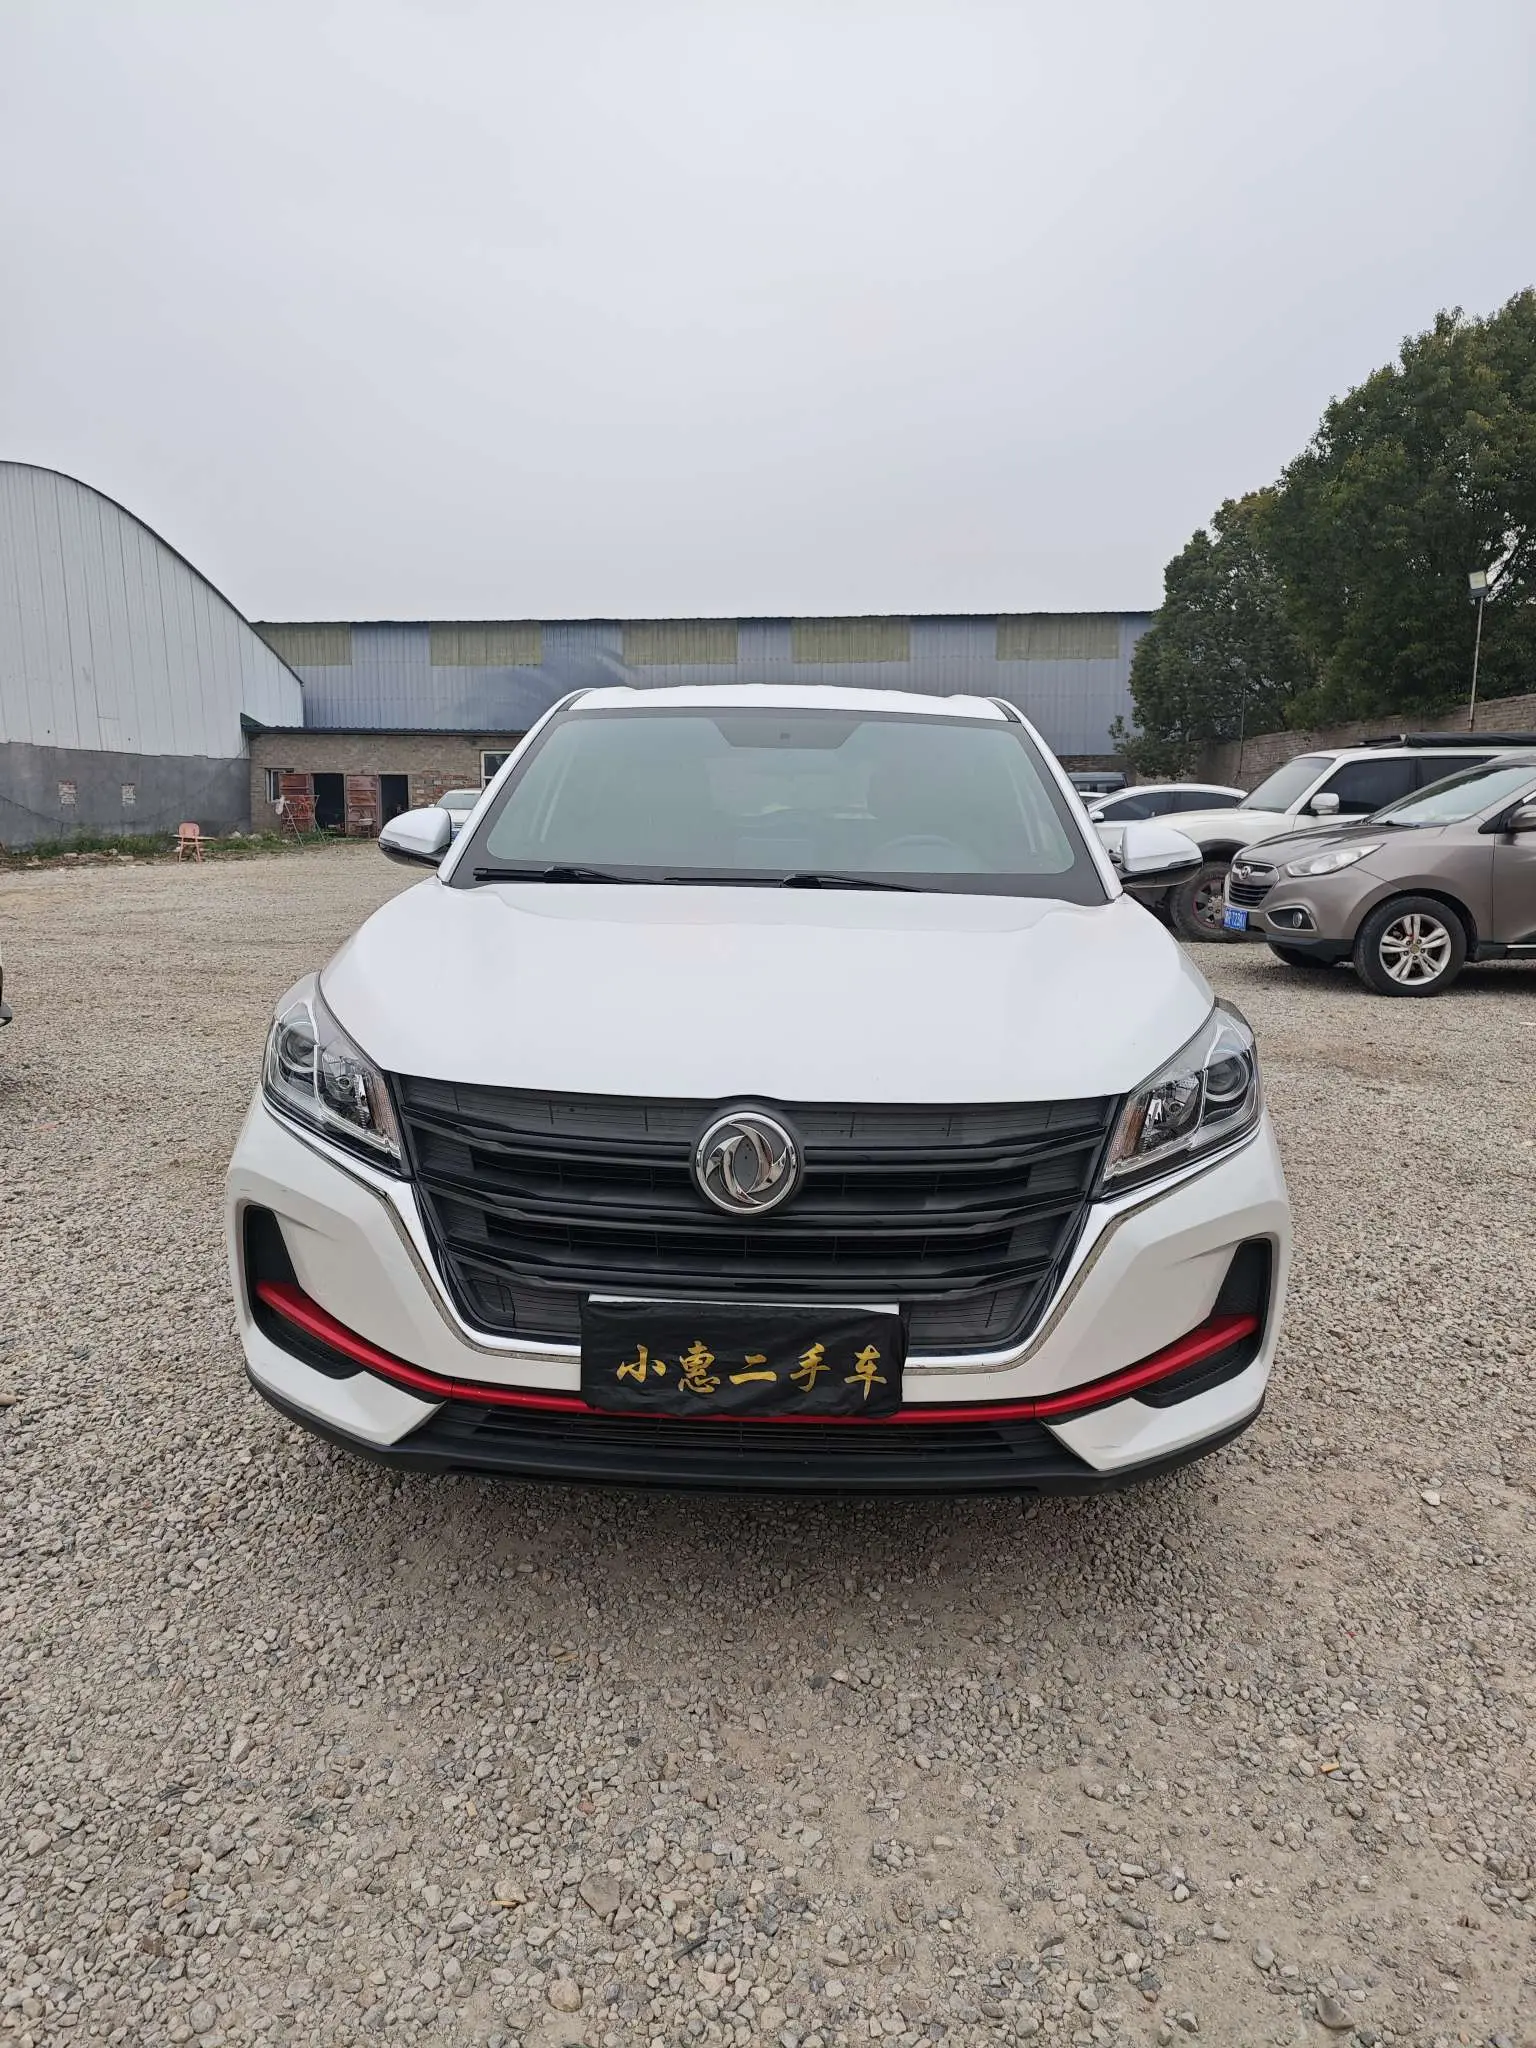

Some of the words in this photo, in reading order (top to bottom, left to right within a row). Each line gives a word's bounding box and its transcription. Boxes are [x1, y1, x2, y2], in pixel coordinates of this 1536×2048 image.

[615, 1340, 888, 1401] 小惠二手车
